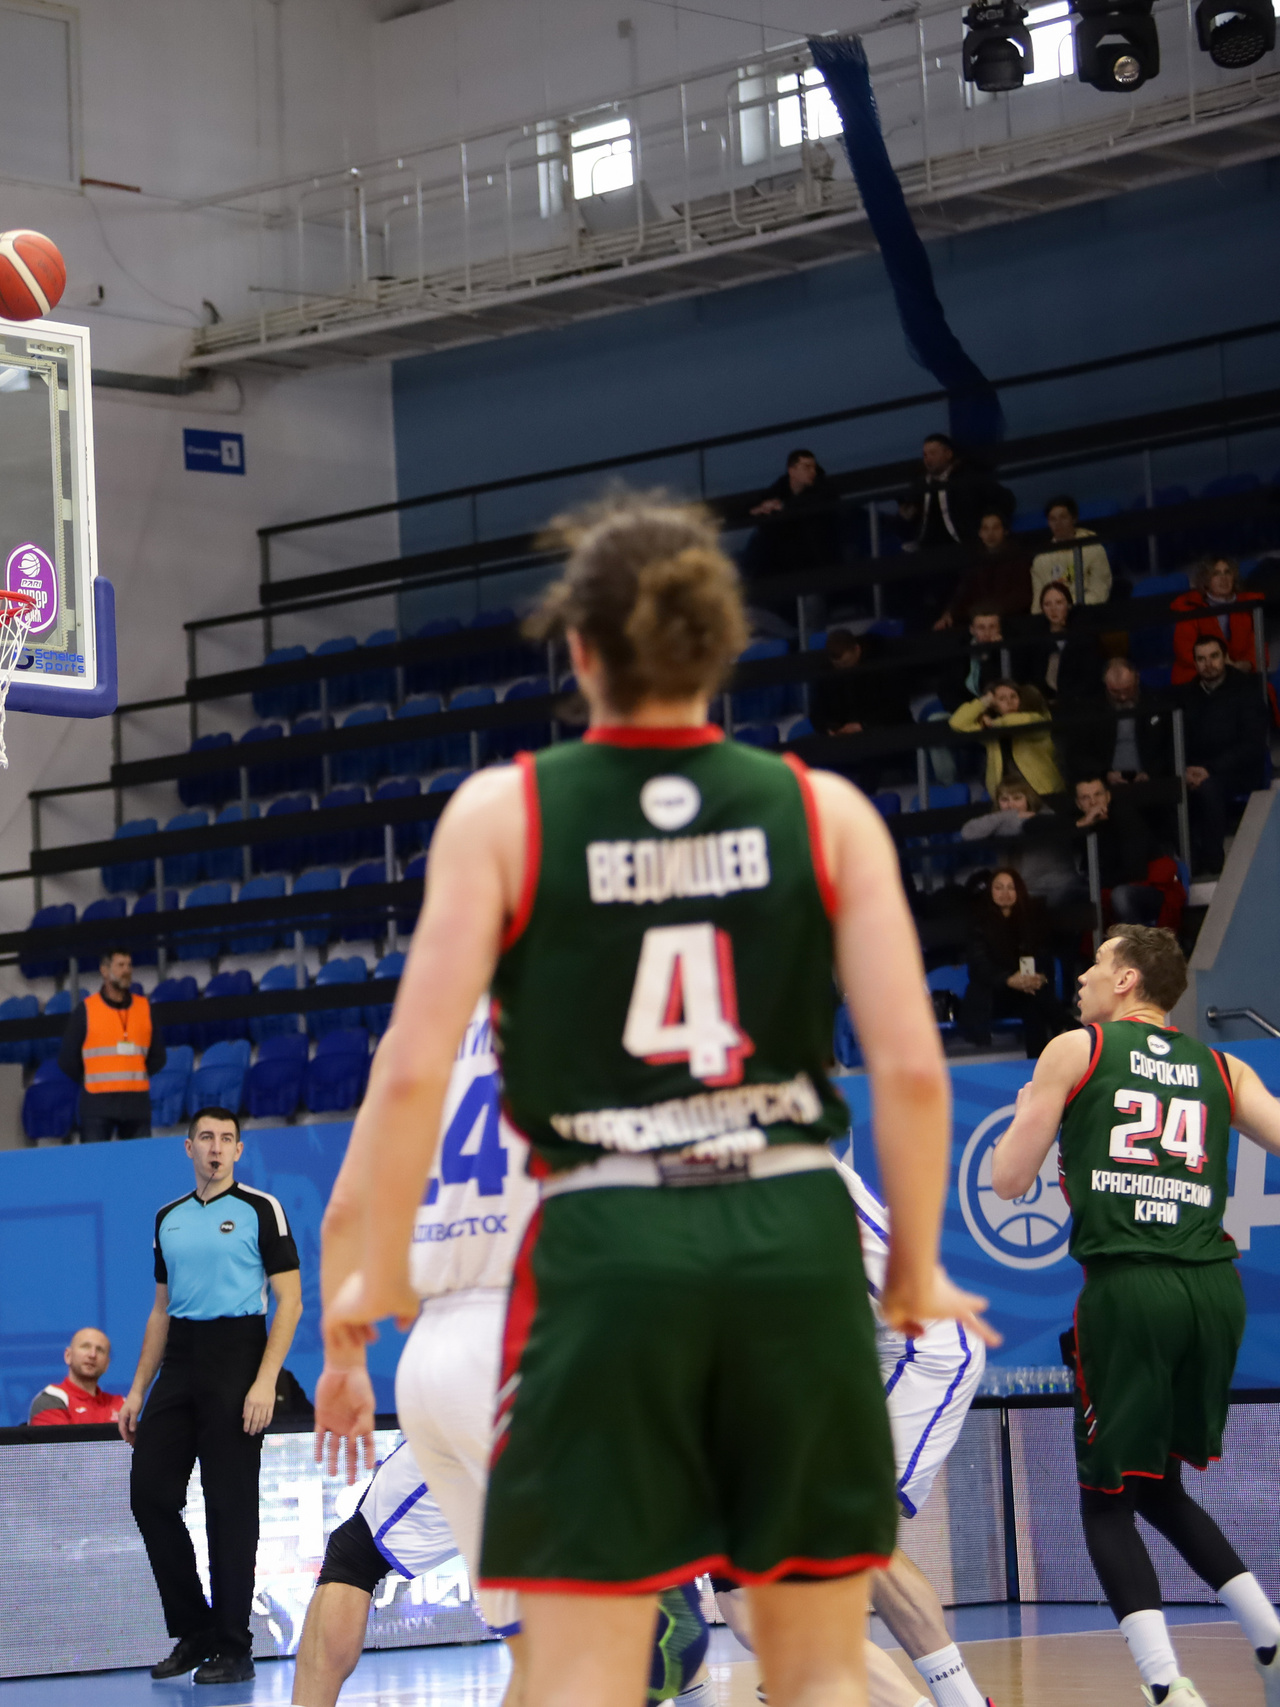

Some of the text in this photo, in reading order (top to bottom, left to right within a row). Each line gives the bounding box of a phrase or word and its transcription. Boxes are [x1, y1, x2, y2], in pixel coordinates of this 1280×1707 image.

[34, 649, 84, 664] Schelde
[35, 659, 84, 673] Sports
[623, 921, 754, 1086] 4
[1130, 1050, 1199, 1088] СОРОКИН
[1109, 1089, 1206, 1172] 24
[1091, 1169, 1212, 1208] КРАСНОДАРСКИЙ
[1134, 1199, 1178, 1225] КРАЙ
